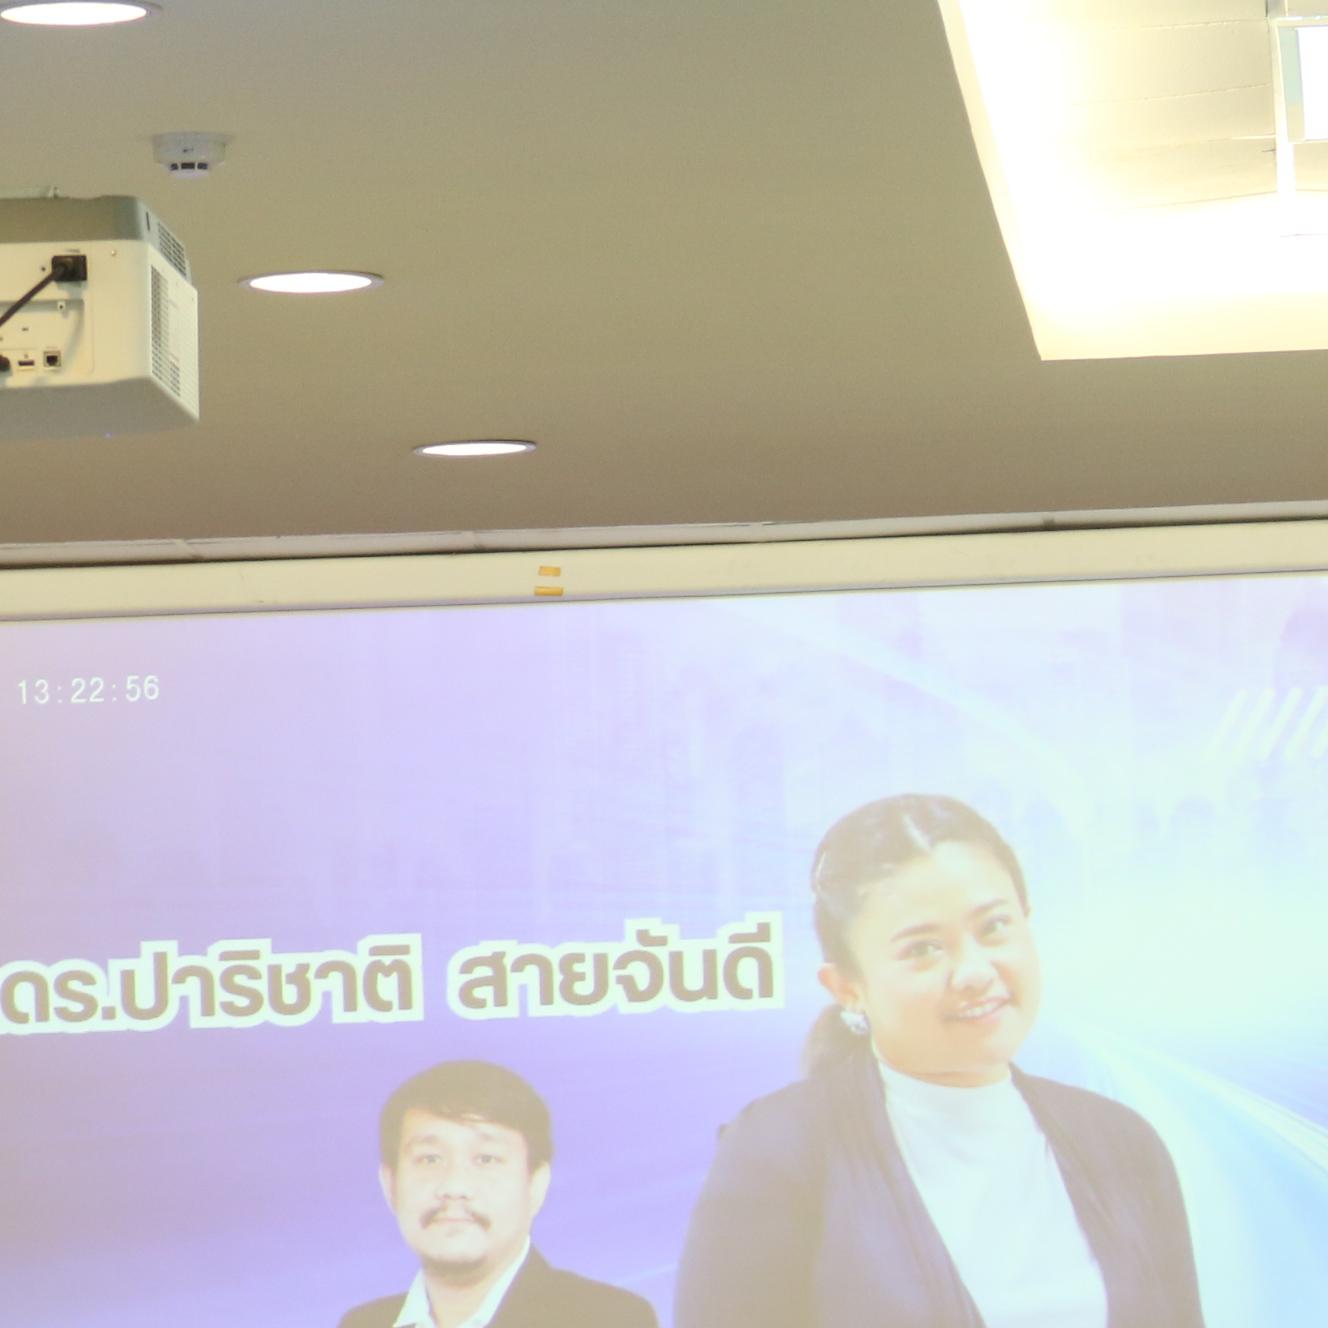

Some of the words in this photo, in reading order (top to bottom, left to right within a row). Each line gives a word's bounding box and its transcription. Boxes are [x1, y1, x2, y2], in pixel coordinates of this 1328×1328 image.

[17, 675, 160, 705] 13:22:56
[456, 917, 778, 1012] สายจันดี
